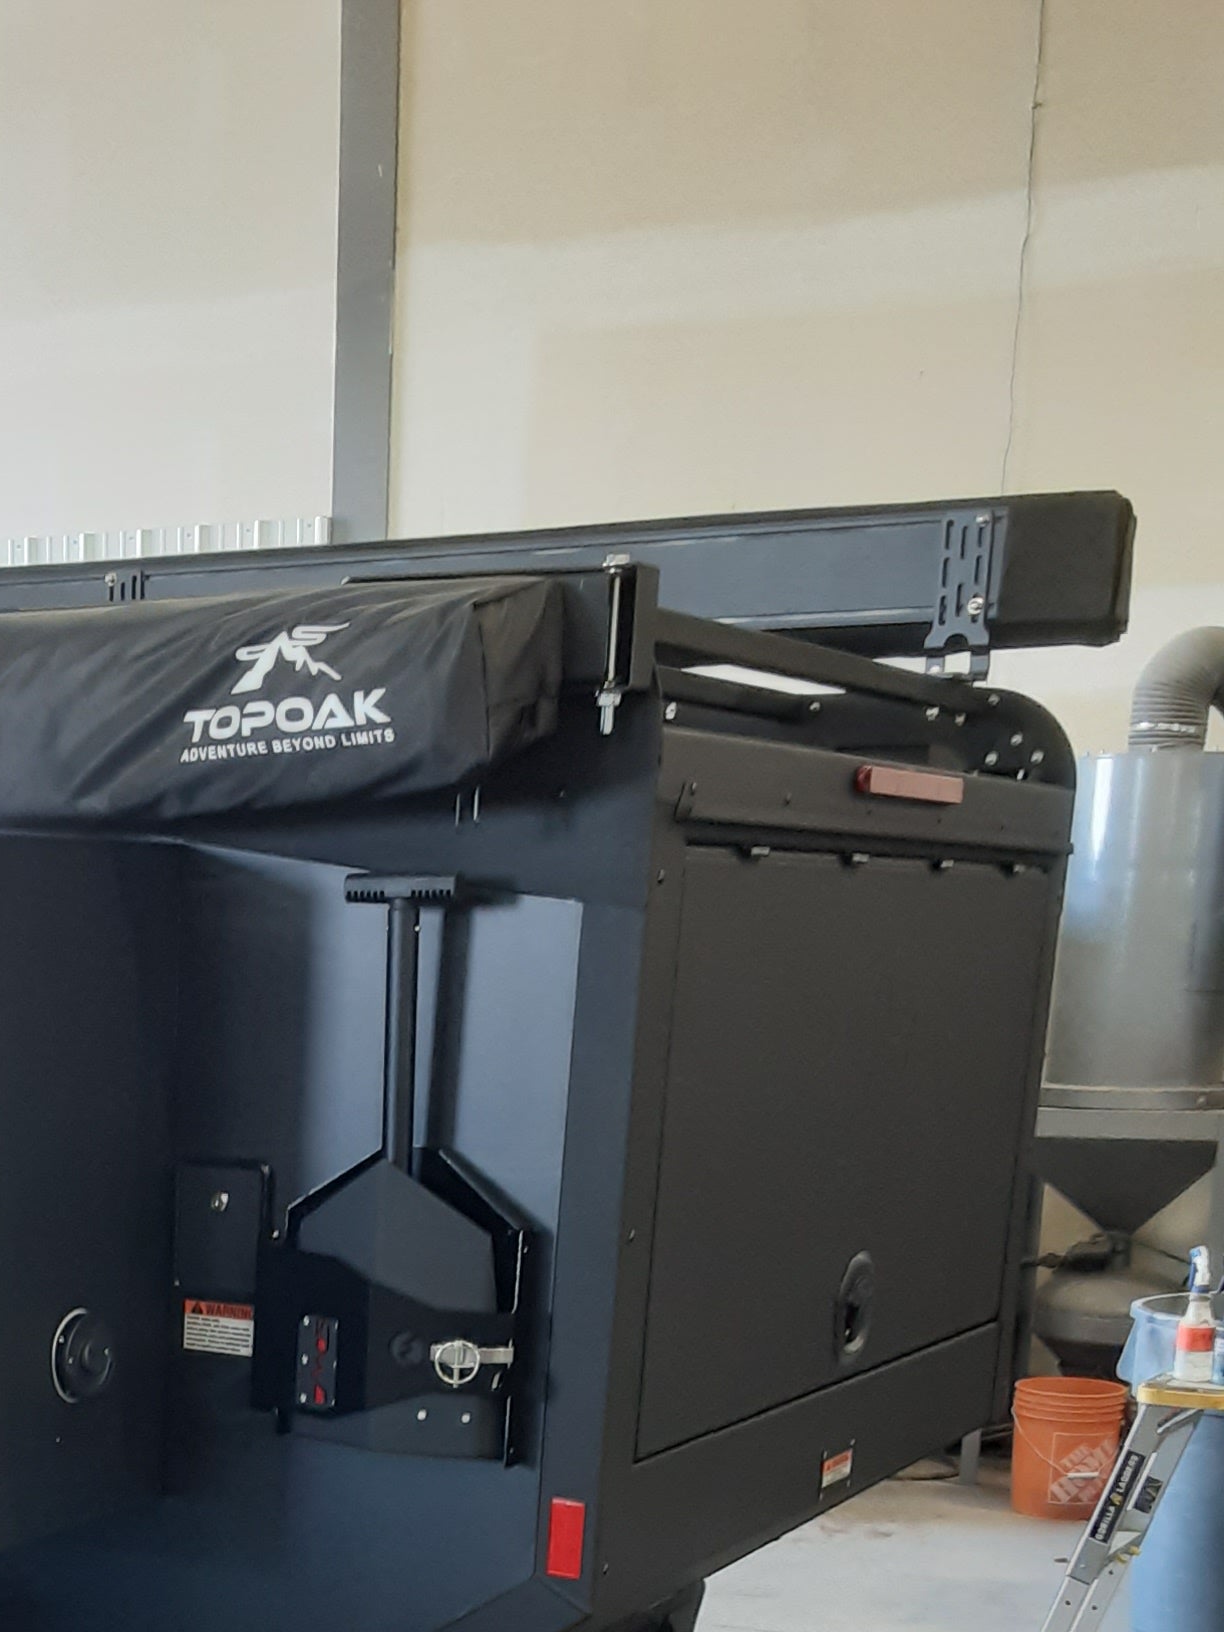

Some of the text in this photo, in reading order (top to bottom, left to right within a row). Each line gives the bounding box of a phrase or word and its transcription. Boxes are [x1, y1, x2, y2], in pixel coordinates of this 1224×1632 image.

[183, 687, 392, 742] TOPOAK
[180, 729, 395, 763] ADVENTURE BEYOND LIMITS
